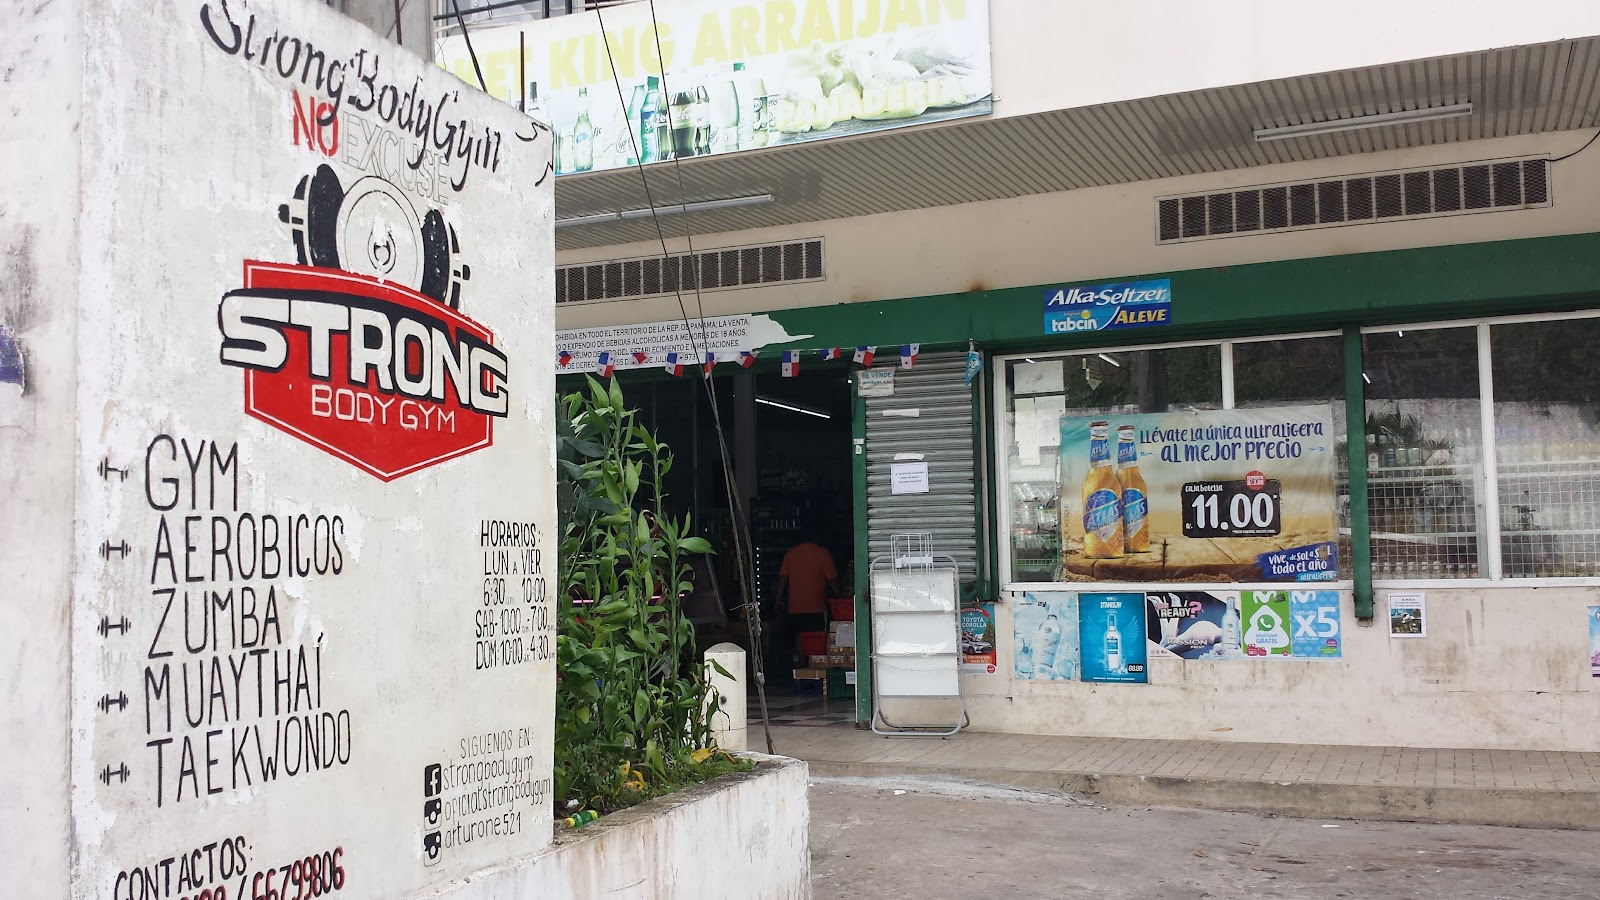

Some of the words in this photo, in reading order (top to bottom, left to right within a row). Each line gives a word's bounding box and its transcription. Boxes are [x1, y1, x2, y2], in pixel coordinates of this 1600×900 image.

[550, 21, 676, 90] KING
[692, 0, 966, 66] ARRAIJAN
[293, 90, 338, 157] NO
[342, 111, 450, 205] EXCUSE
[1047, 288, 1167, 306] Alka-Seltzer
[588, 331, 604, 339] TODO
[613, 327, 647, 337] TERRITORIO
[648, 326, 657, 334] DE
[657, 325, 666, 333] LA
[681, 323, 690, 331] DE
[718, 320, 726, 328] LA
[1052, 317, 1098, 332] tabcin
[1115, 309, 1168, 325] ALEVE
[219, 290, 508, 418] STRONG
[567, 341, 597, 350] EXPENDIO
[597, 340, 605, 348] DE
[606, 338, 631, 347] BEBIDAS
[631, 335, 673, 345] ALCOHOLICAS
[711, 331, 719, 339] DE
[721, 330, 727, 338] 18
[618, 348, 629, 356] DEL
[312, 384, 394, 424] BODY
[399, 397, 456, 434] GYM
[145, 434, 238, 512] GYM
[1087, 502, 1119, 529] ATLAS
[1192, 493, 1274, 531] 11.00
[481, 520, 541, 547] HORARIOS:
[151, 513, 345, 584] AEROBICOS
[484, 550, 509, 575] LUN
[521, 549, 541, 575] VIER
[1272, 562, 1295, 574] todo
[1308, 559, 1327, 571] año
[483, 578, 505, 606] 6:30
[522, 577, 546, 603] 10:00
[148, 585, 282, 659] ZUMBA
[1161, 601, 1202, 618] READY?
[147, 709, 351, 808] TAEKWONDO
[460, 730, 513, 759] SIGUENOS
[114, 836, 253, 900] CONTACTOS:
